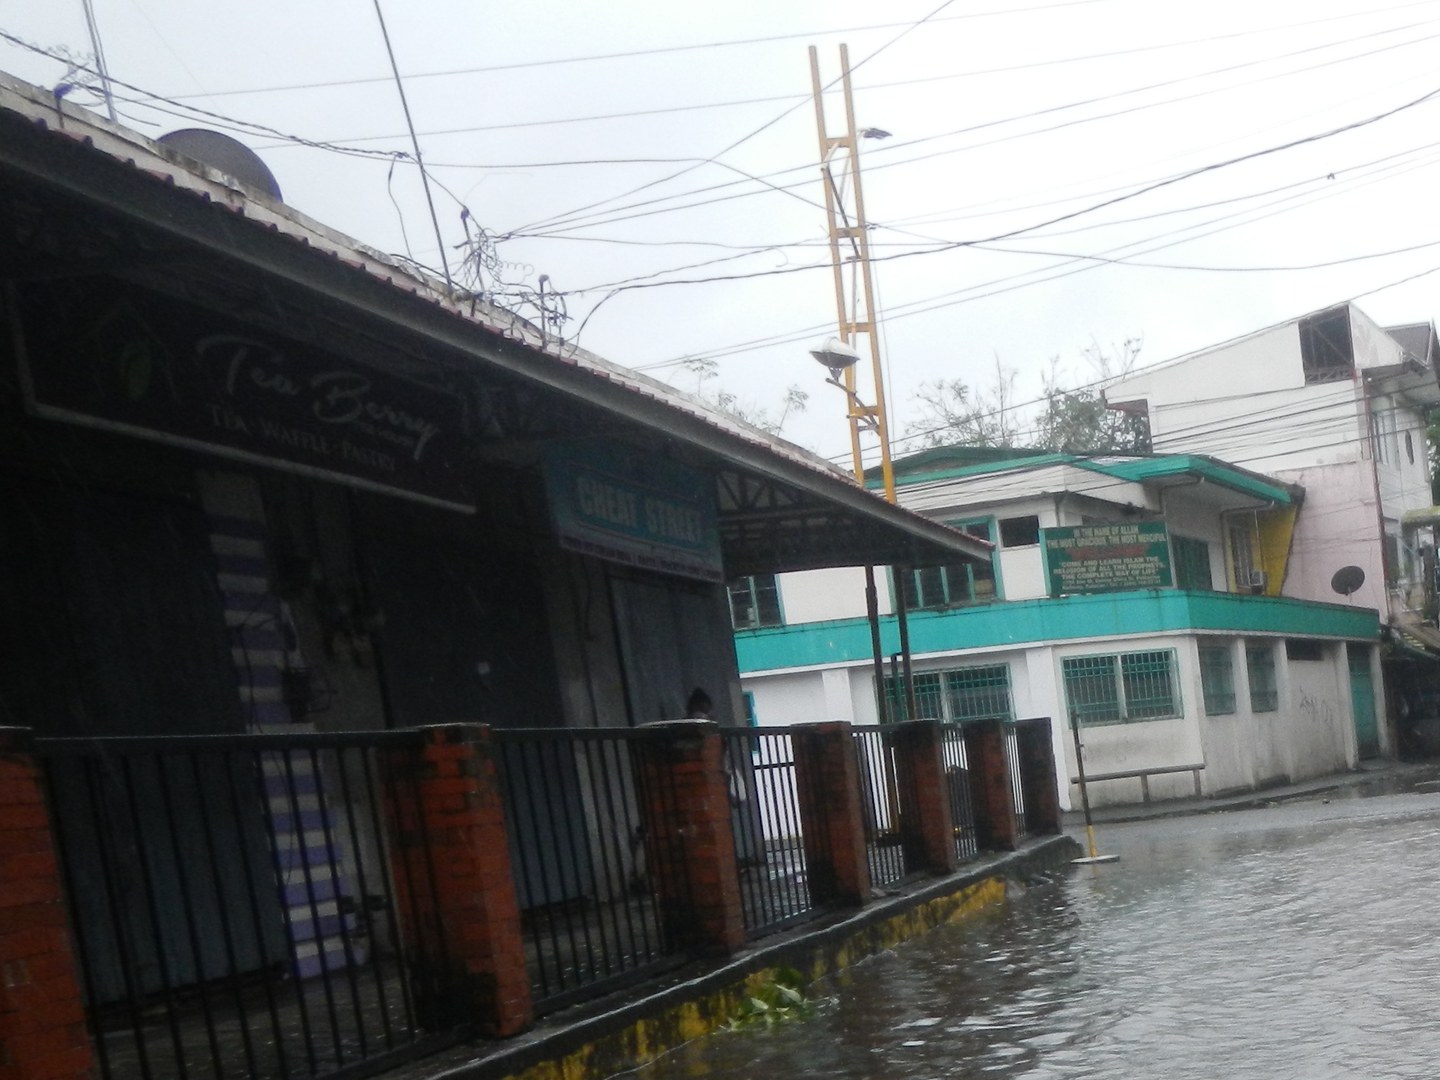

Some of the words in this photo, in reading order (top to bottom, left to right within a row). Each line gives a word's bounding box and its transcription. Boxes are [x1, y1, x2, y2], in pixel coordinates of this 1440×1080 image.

[195, 333, 302, 397] Tea
[310, 369, 440, 461] Berry
[644, 495, 704, 543] STREET
[1059, 538, 1075, 548] MOST
[1120, 534, 1137, 544] MOST
